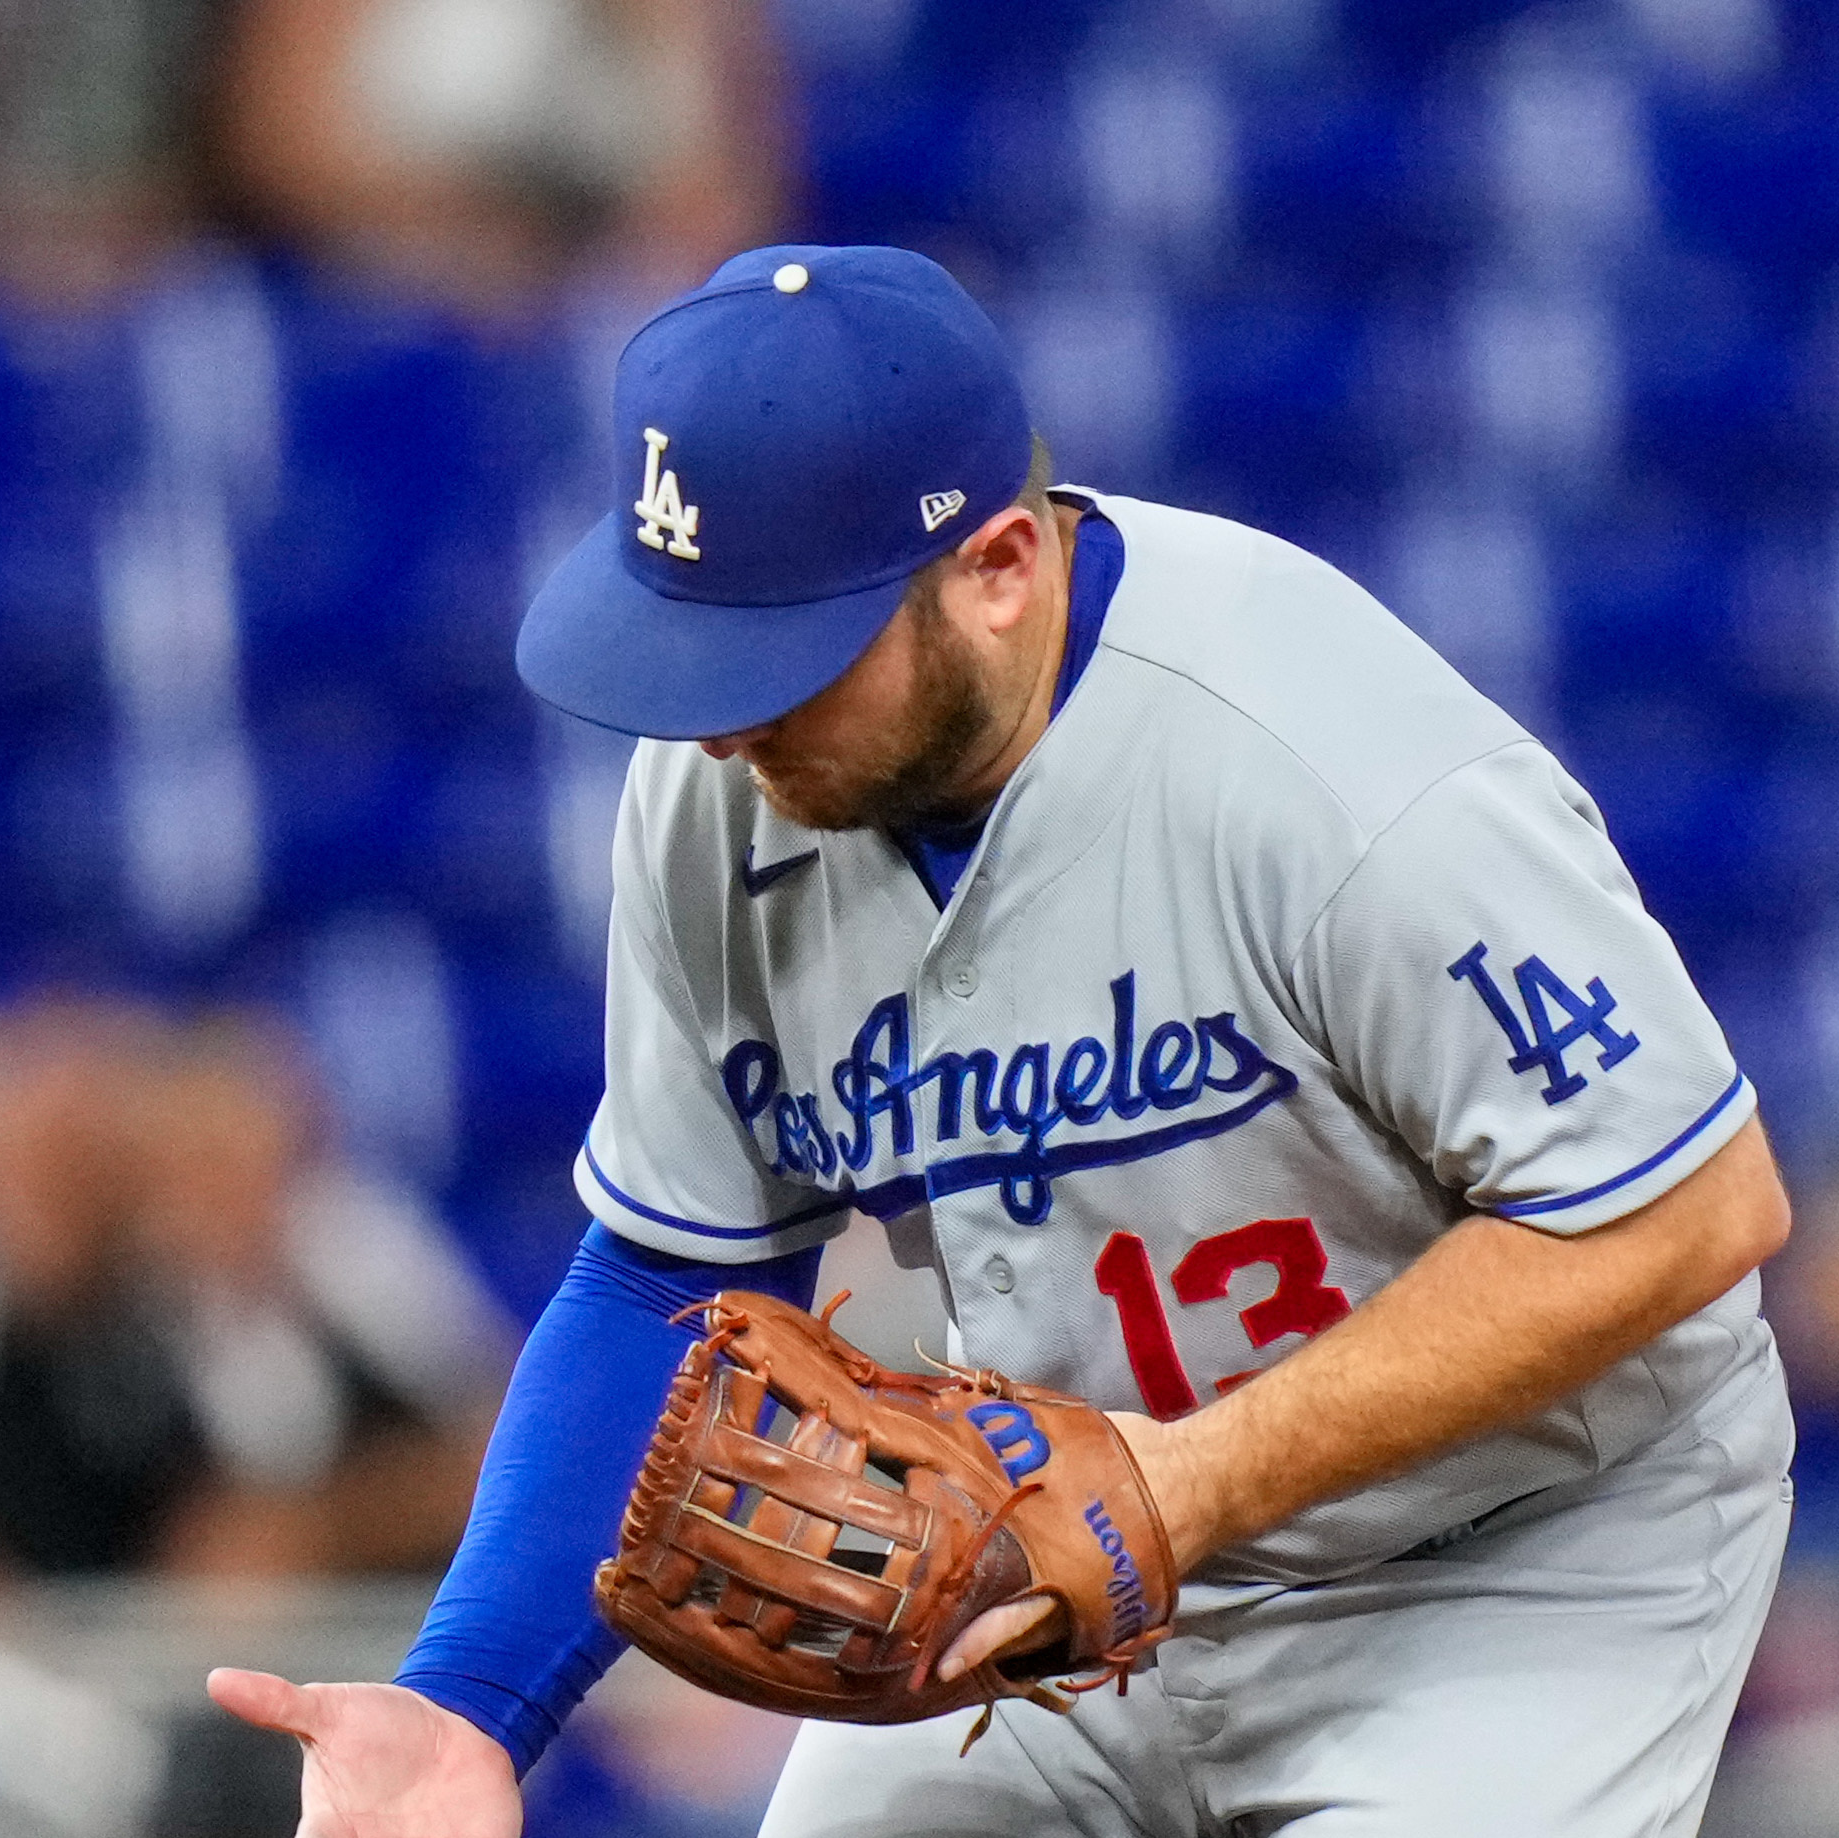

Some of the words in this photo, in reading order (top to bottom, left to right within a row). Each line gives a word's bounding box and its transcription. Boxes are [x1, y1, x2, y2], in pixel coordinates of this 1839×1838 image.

[634, 427, 701, 561] LA
[719, 1038, 838, 1177] Los
[832, 968, 1272, 1225] Angeles
[1447, 940, 1641, 1106] LA
[1094, 1217, 1353, 1423] 13
